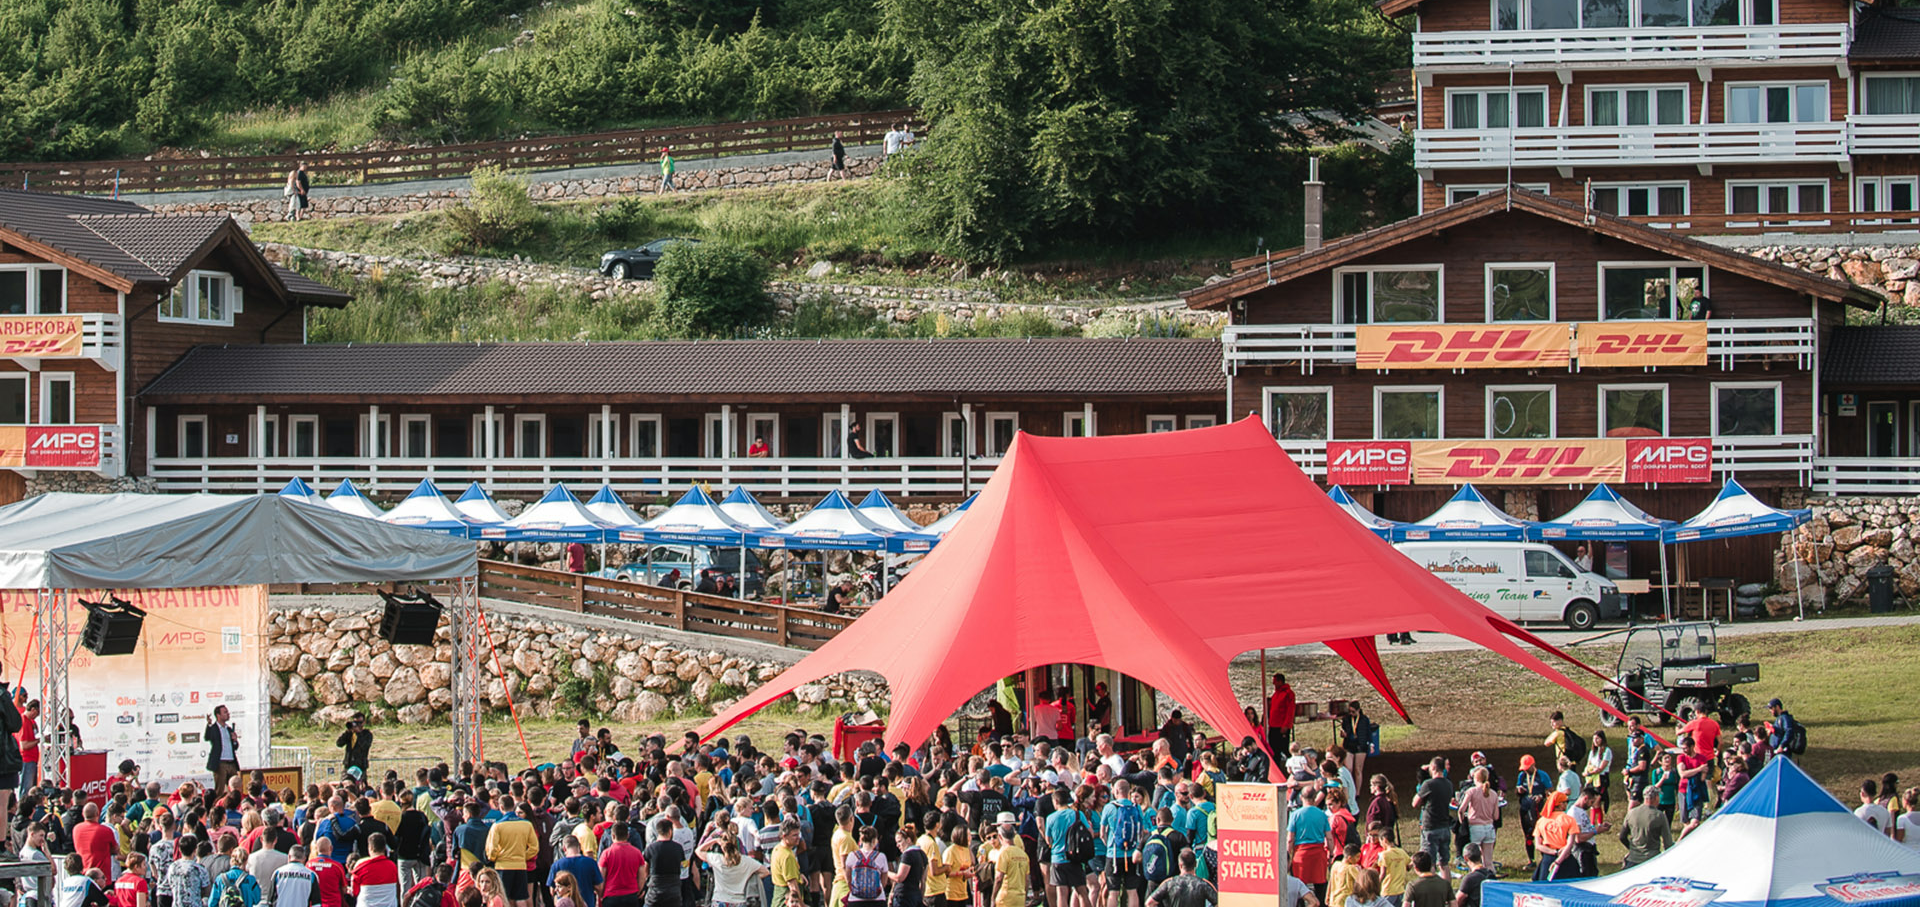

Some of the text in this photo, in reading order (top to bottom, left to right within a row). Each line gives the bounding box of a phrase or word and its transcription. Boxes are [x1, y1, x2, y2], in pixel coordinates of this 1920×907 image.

[0, 317, 77, 335] RDEROBĂ
[4, 340, 62, 353] DHL
[1384, 330, 1542, 363] DHL
[1595, 334, 1690, 354] DHL
[31, 433, 96, 449] MPG
[1333, 448, 1407, 465] MPG
[1445, 446, 1595, 478] DHL
[1633, 446, 1708, 463] MPG
[1496, 588, 1529, 600] Team
[159, 632, 206, 646] MPG
[81, 780, 106, 794] MPG
[1242, 792, 1267, 801] DHL
[1223, 839, 1272, 858] SCHIMB
